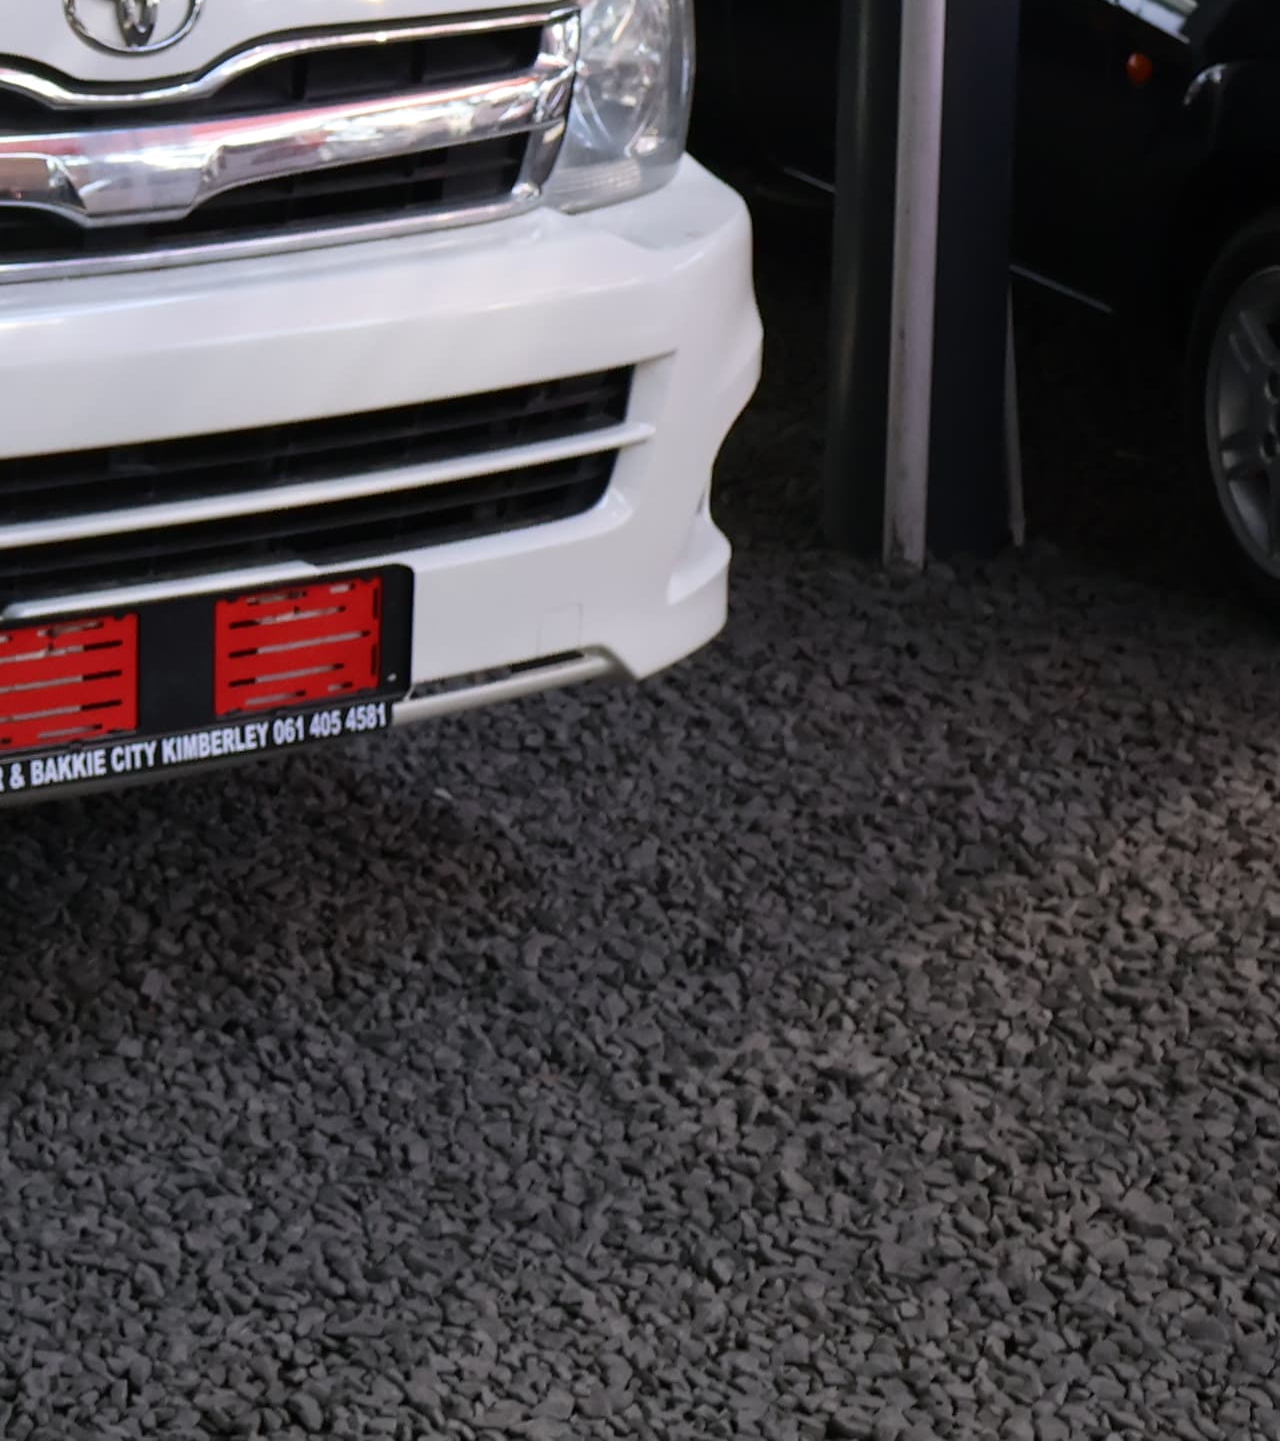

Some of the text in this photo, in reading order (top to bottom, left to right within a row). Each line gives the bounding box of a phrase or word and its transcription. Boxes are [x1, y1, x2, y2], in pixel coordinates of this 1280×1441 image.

[9, 762, 26, 790] &
[30, 748, 107, 786] BAKKIE
[110, 740, 157, 772] CITY
[161, 721, 269, 764] KIMBERLEY
[273, 715, 306, 745] 061
[309, 709, 342, 737] 405
[345, 702, 386, 731] 4581
